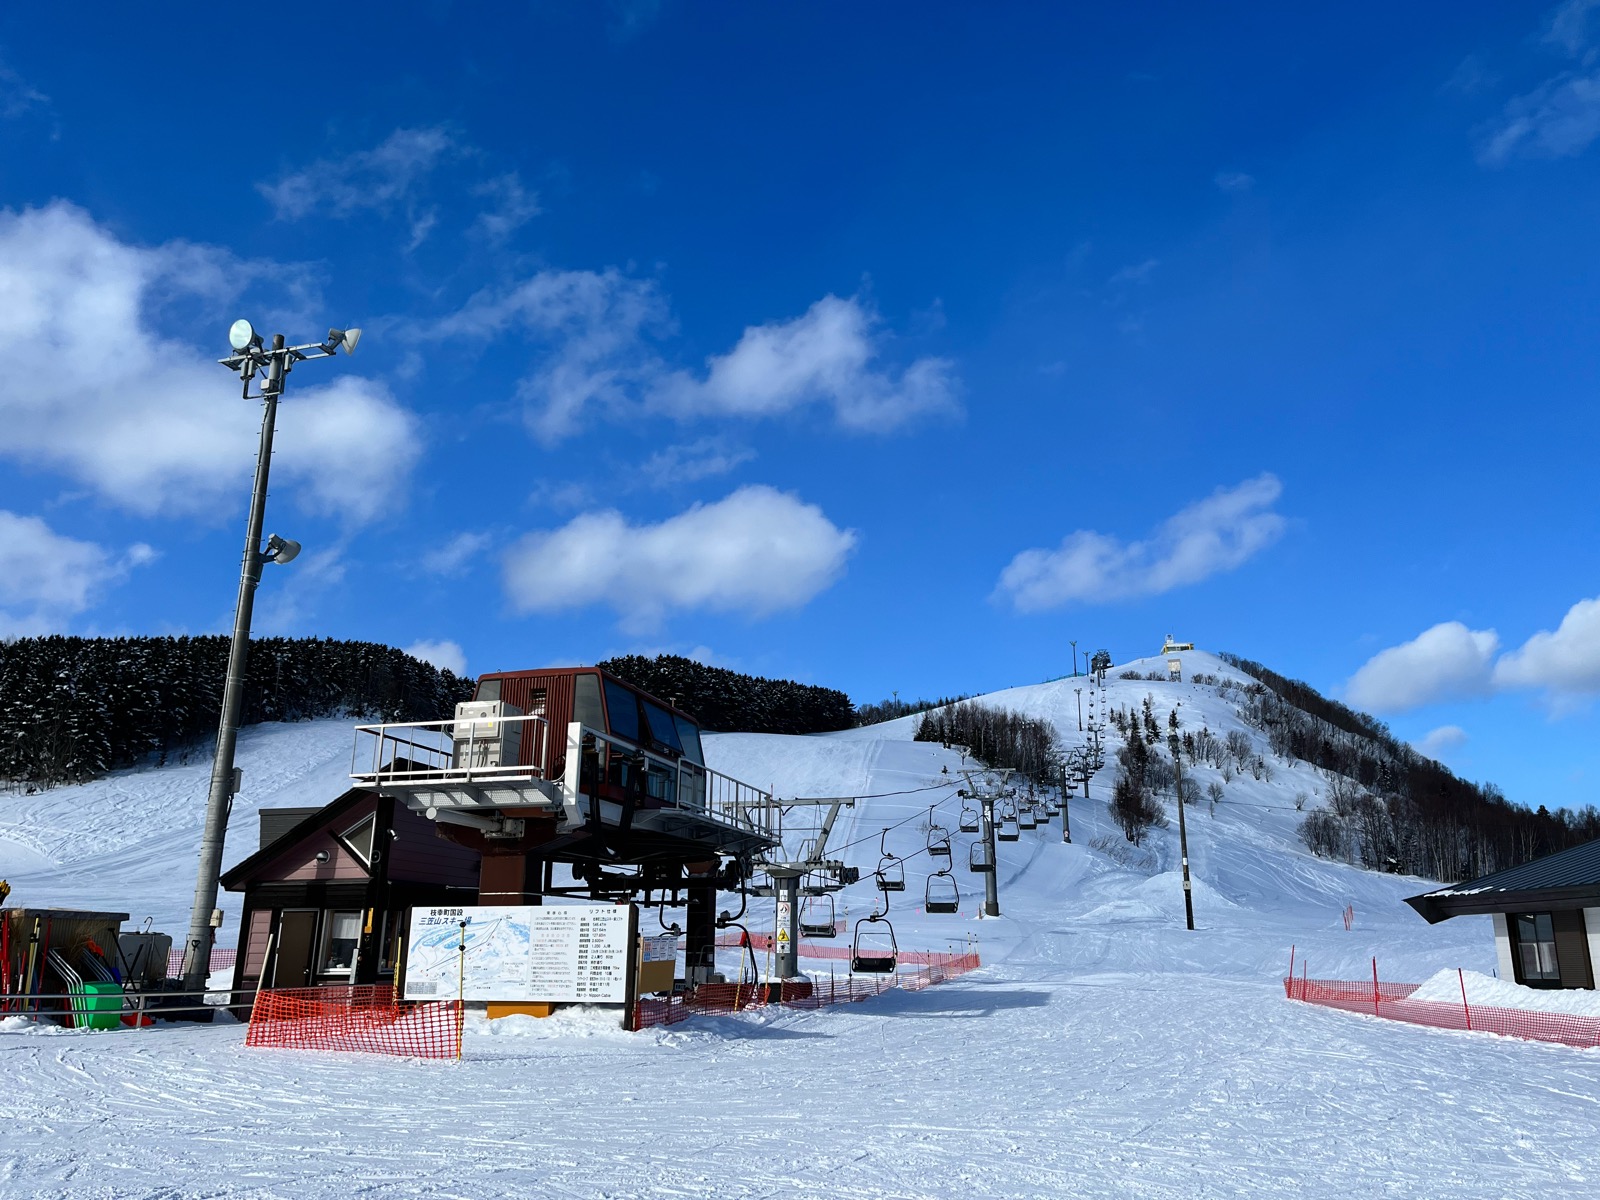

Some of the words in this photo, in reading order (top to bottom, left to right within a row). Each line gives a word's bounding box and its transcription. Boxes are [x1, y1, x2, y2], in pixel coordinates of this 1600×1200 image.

[418, 916, 472, 926] 三笠山スキー場
